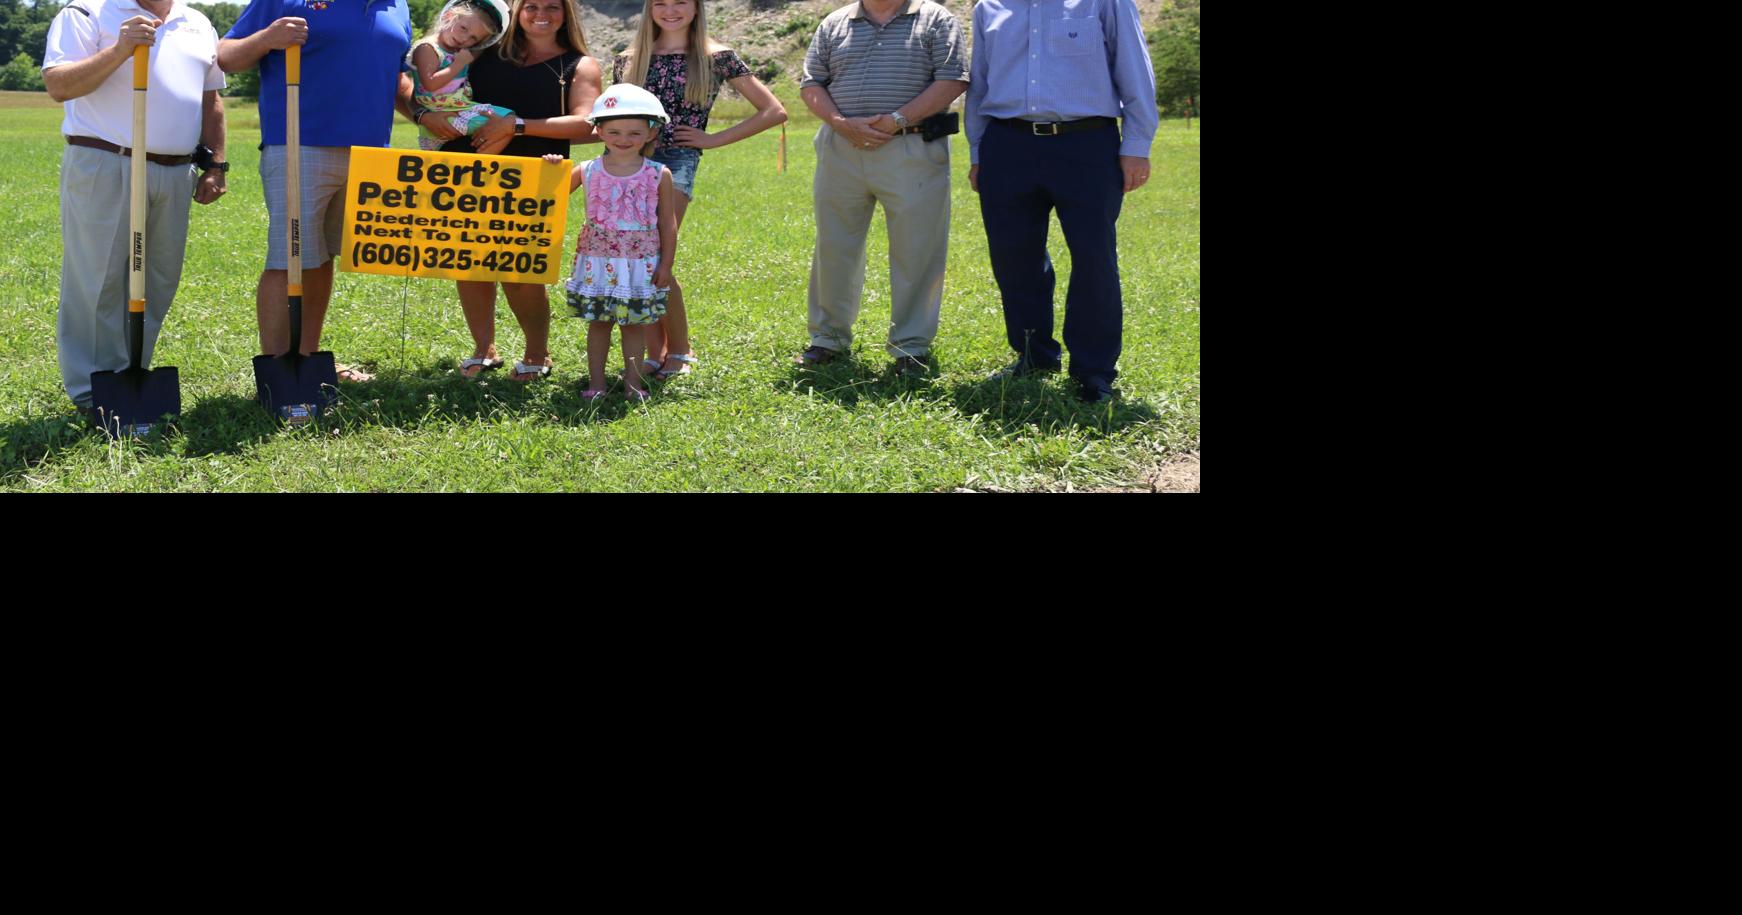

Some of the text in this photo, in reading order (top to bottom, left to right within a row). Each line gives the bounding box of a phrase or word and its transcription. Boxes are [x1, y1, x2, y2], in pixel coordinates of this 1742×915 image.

[397, 155, 522, 189] Bert's
[358, 182, 555, 216] Pet Center
[354, 224, 551, 247] Next To Lowe's
[356, 210, 552, 233] Diederich Blvd.
